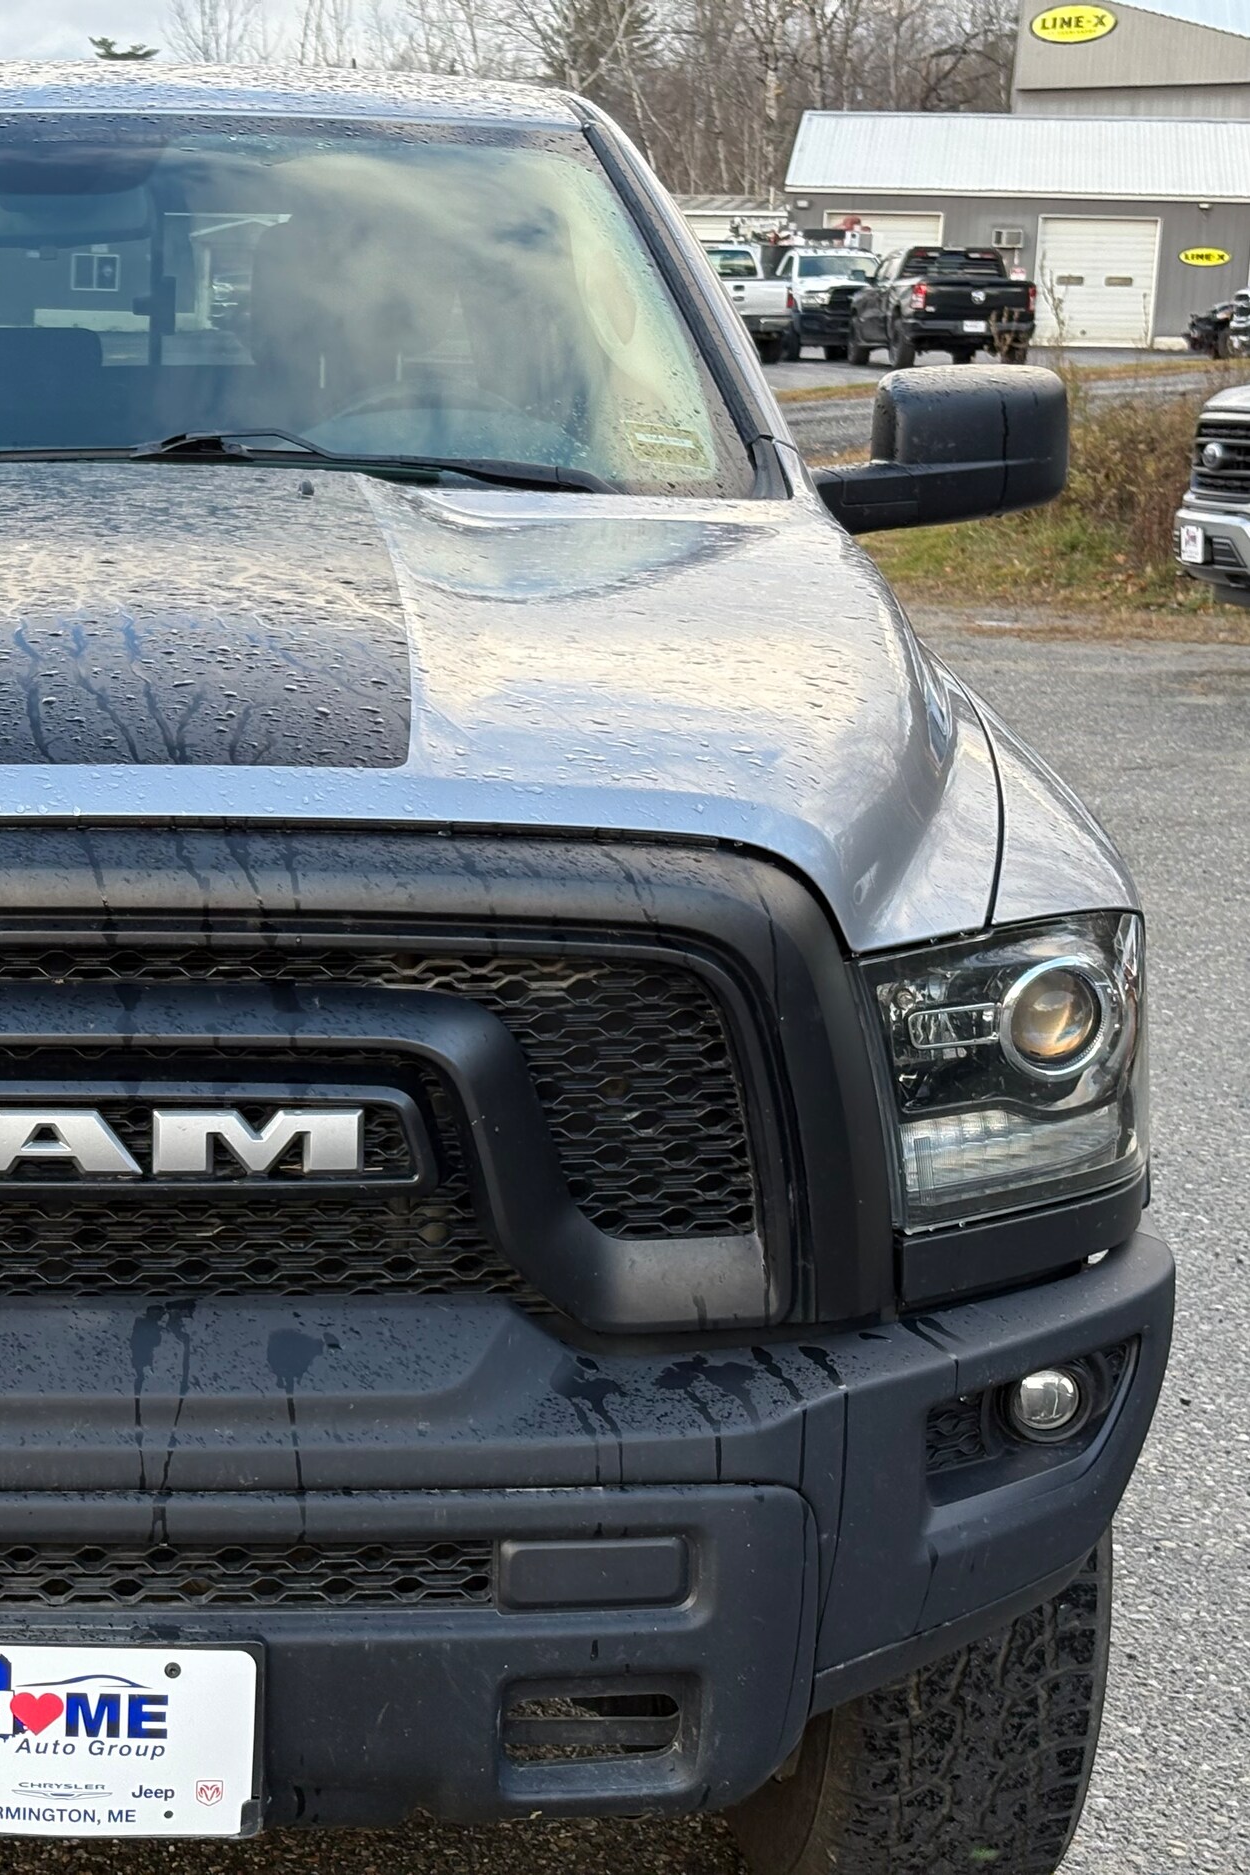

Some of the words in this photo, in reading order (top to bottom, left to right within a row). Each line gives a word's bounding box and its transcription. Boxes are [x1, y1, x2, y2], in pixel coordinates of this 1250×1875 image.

[1040, 14, 1107, 30] LINE-X
[1184, 253, 1225, 261] LINE-X
[15, 1738, 76, 1756] Auto
[88, 1739, 166, 1760] Group
[18, 1781, 106, 1790] CHRYSLER
[131, 1785, 175, 1801] Jeep
[107, 1809, 137, 1823] ME
